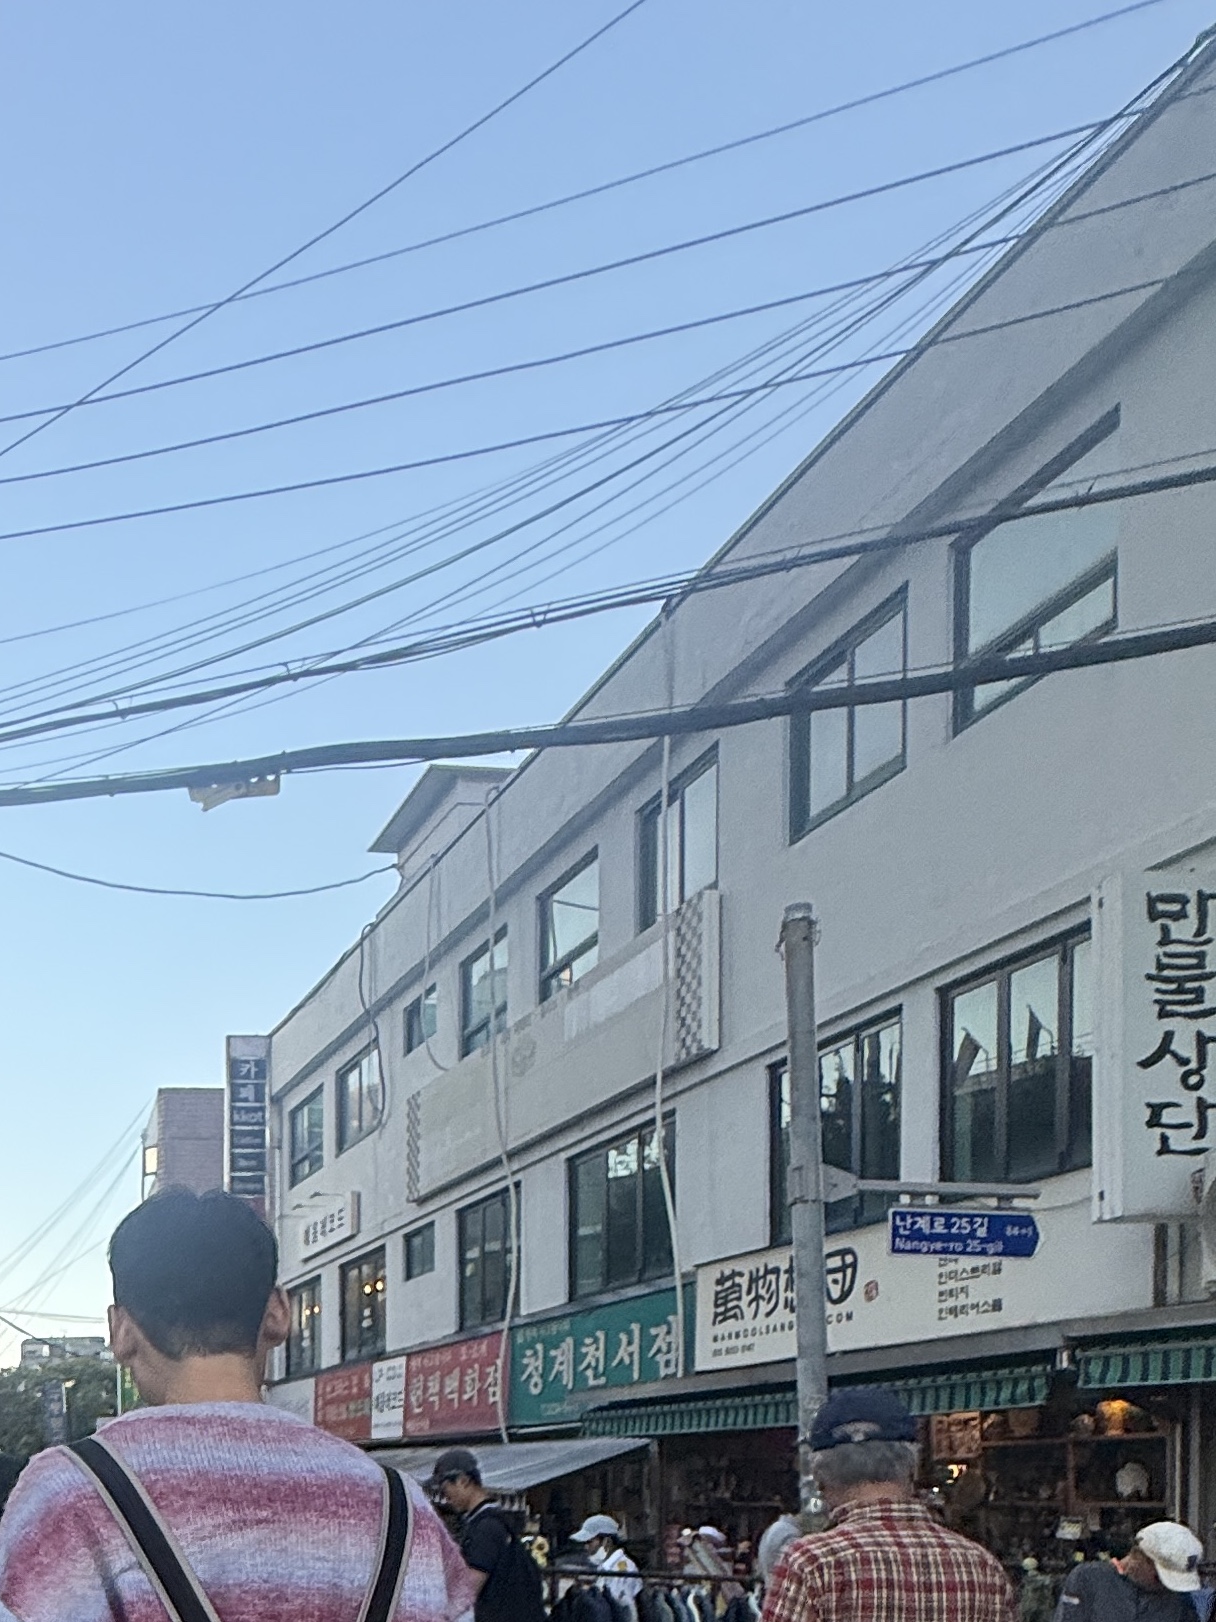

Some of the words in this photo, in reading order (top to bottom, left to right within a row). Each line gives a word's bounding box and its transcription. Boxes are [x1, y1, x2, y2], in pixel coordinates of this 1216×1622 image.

[1137, 889, 1216, 1156] 만물상단
[894, 1237, 964, 1253] Nangye-ro
[965, 1239, 1004, 1254] 25-gil
[895, 1215, 989, 1238] 난계로25길
[520, 1315, 680, 1396] 청계천서점
